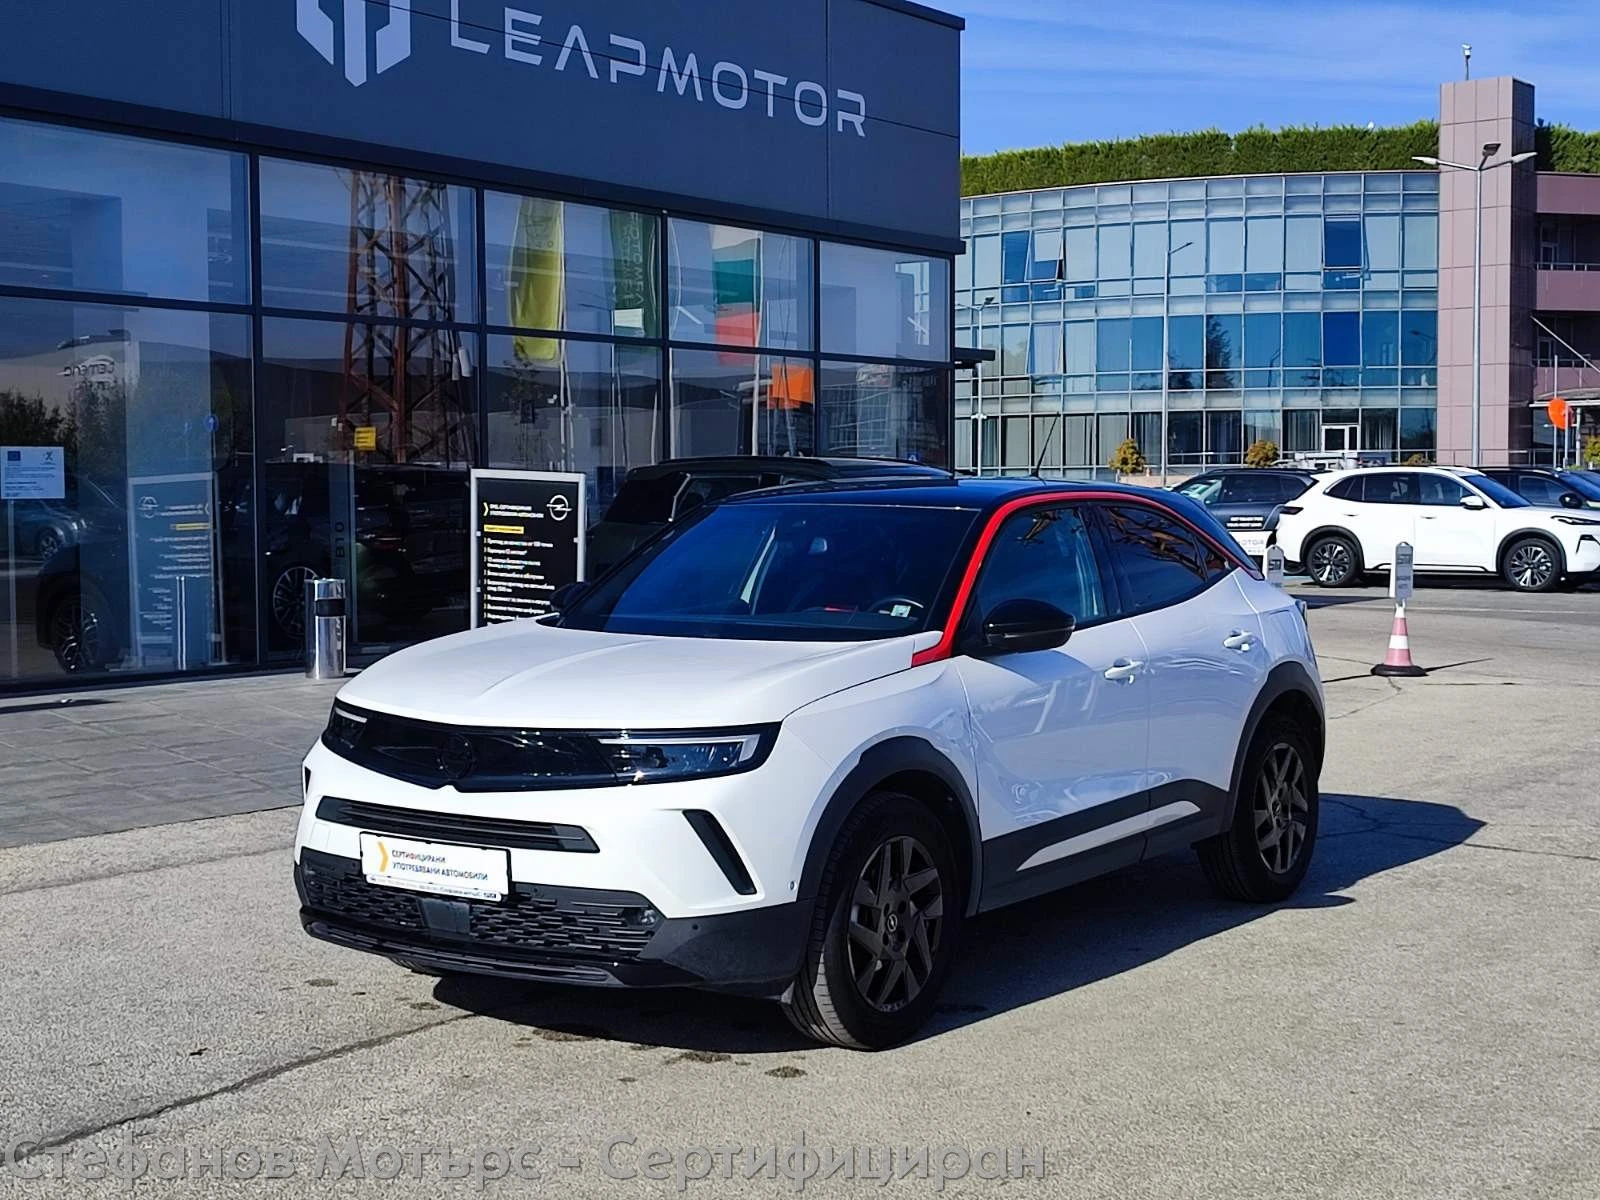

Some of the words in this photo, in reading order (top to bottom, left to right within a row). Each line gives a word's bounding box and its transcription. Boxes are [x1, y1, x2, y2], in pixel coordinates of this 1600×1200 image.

[450, 0, 866, 138] LEAPMOTOR
[391, 849, 446, 864] СЕРТИФИЦИРАНИ
[392, 862, 441, 876] УПОТРЕБЯВАНИ
[441, 869, 488, 881] АВТОМОБИЛИ
